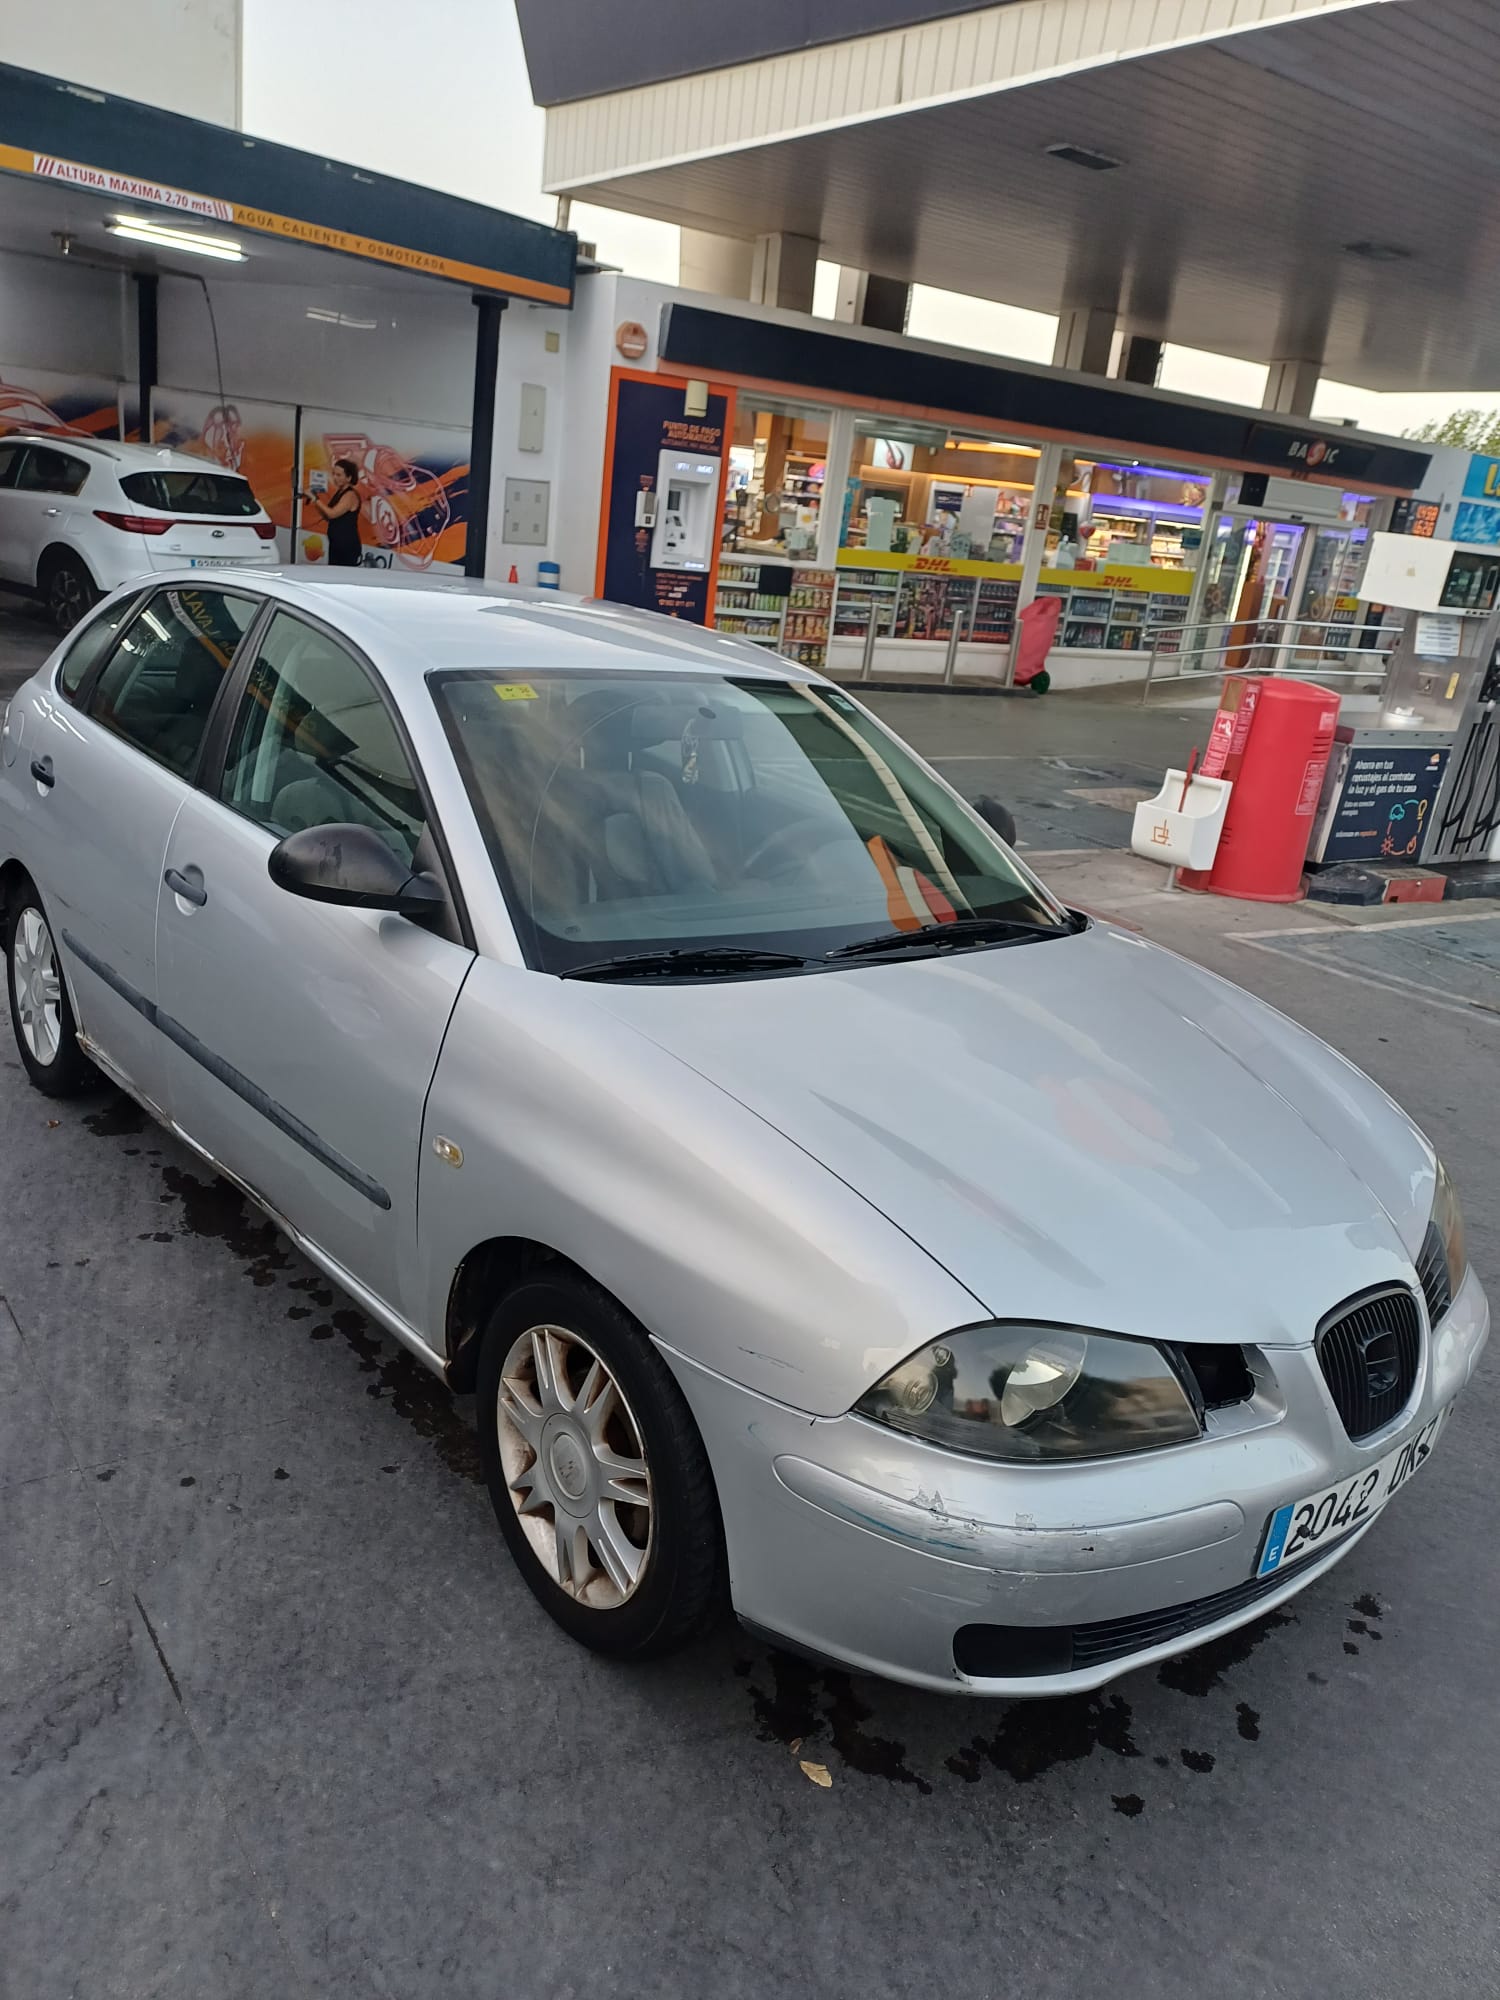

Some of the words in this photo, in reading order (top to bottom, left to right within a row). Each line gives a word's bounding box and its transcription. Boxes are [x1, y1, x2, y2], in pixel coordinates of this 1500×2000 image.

[56, 163, 106, 188] ALTURA
[109, 176, 162, 202] MAXIMA
[165, 190, 188, 208] 2.70
[191, 201, 213, 214] mts
[237, 208, 275, 228] AGUA
[281, 220, 348, 248] CALIENTE
[355, 240, 363, 250] Y
[367, 242, 446, 272] OSMOTIZADA
[913, 557, 951, 571] DHL
[1103, 575, 1132, 588] DHL
[1268, 1546, 1280, 1562] E
[1283, 1468, 1380, 1558] 2042
